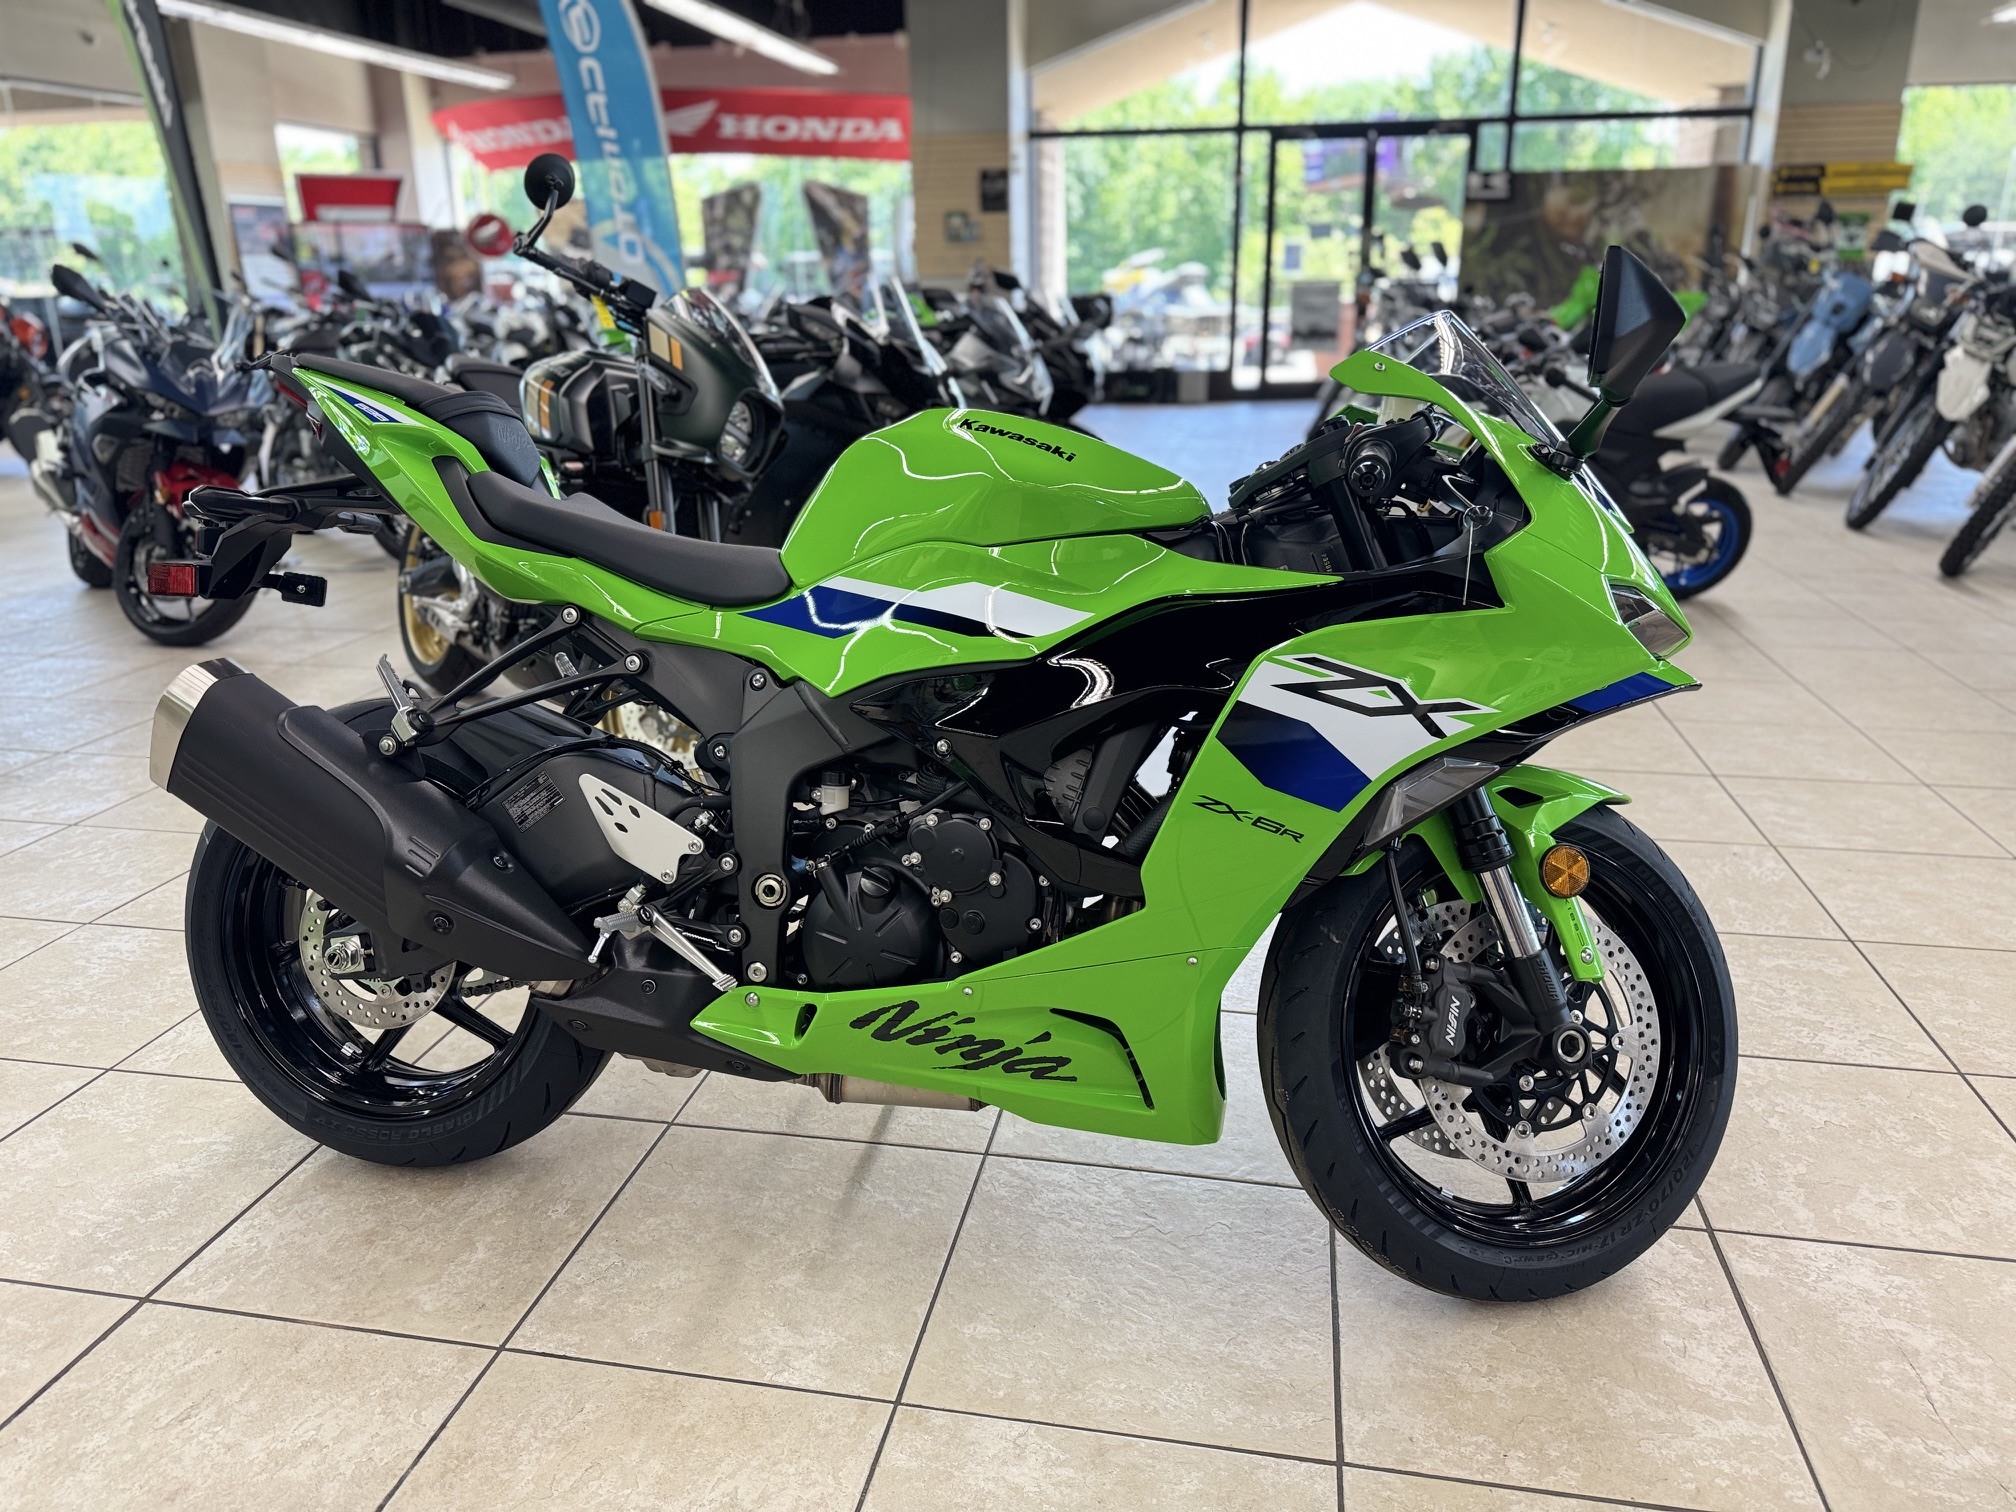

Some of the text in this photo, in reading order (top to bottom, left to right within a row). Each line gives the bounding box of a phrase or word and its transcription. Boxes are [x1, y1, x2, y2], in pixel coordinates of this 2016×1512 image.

[716, 112, 905, 142] HONDA
[960, 419, 1077, 462] Kawasaki
[1270, 656, 1482, 740] ZX
[1191, 794, 1305, 844] ZX-6R
[1536, 958, 1560, 1001] SHOWA
[849, 1000, 1078, 1082] Ninja
